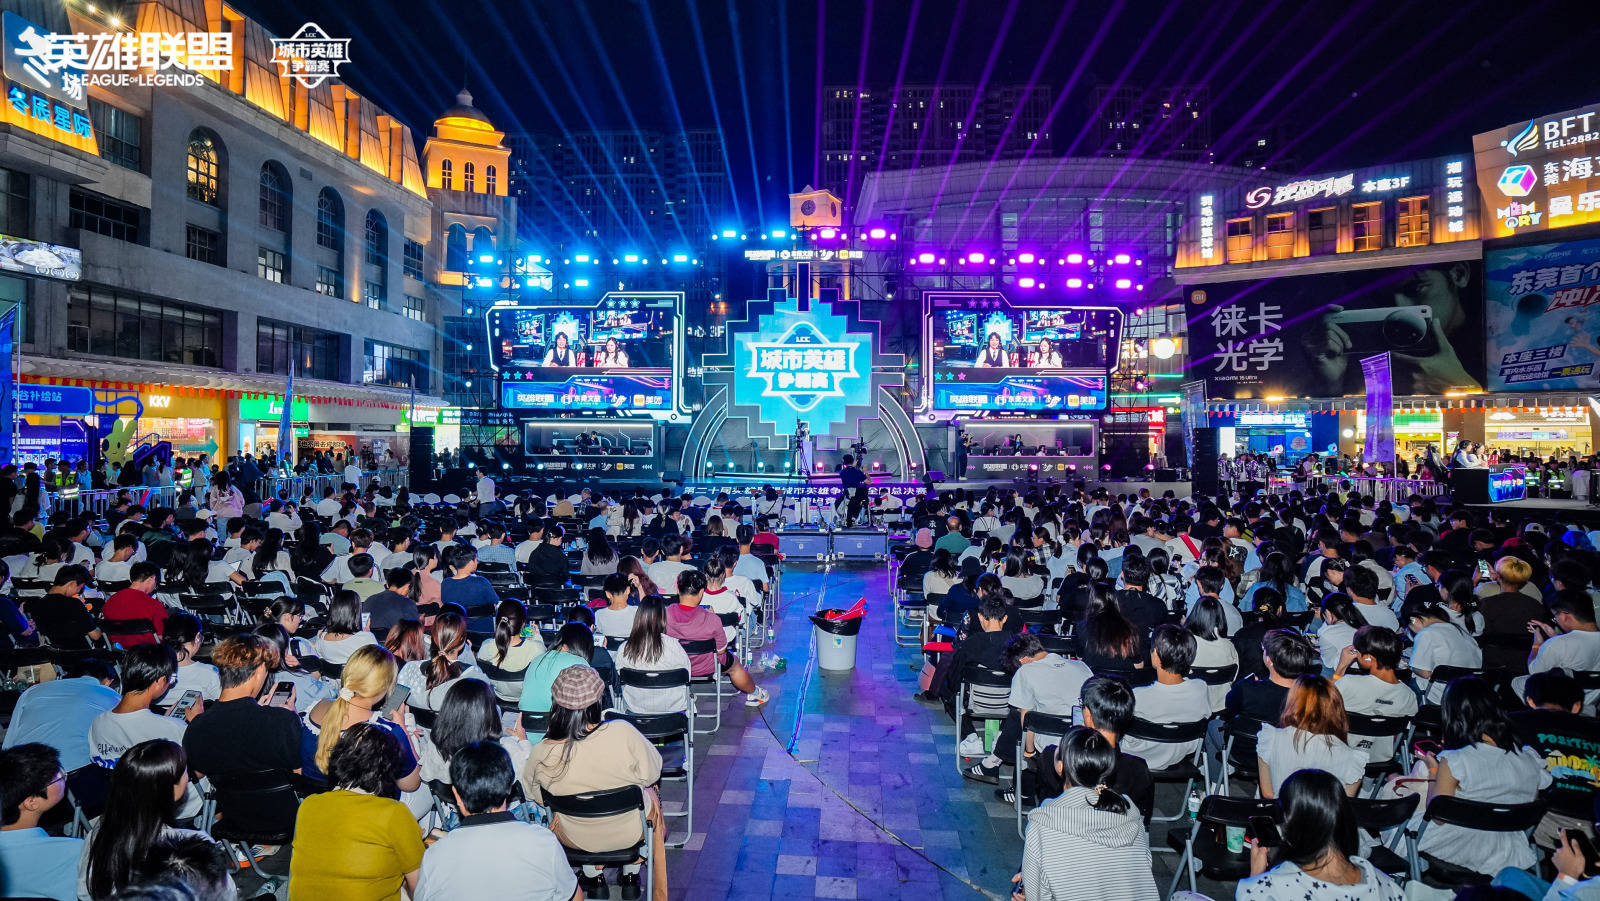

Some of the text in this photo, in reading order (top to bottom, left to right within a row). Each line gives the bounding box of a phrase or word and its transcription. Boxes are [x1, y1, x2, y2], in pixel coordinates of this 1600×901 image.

[1543, 111, 1596, 141] BFT
[1544, 131, 1600, 150] TEL:2882
[1509, 262, 1600, 294] 东莞首个
[1211, 302, 1284, 337] 徕卡
[760, 349, 846, 371] 城市英雄
[1213, 337, 1284, 372] 光学
[149, 394, 171, 408] KKV
